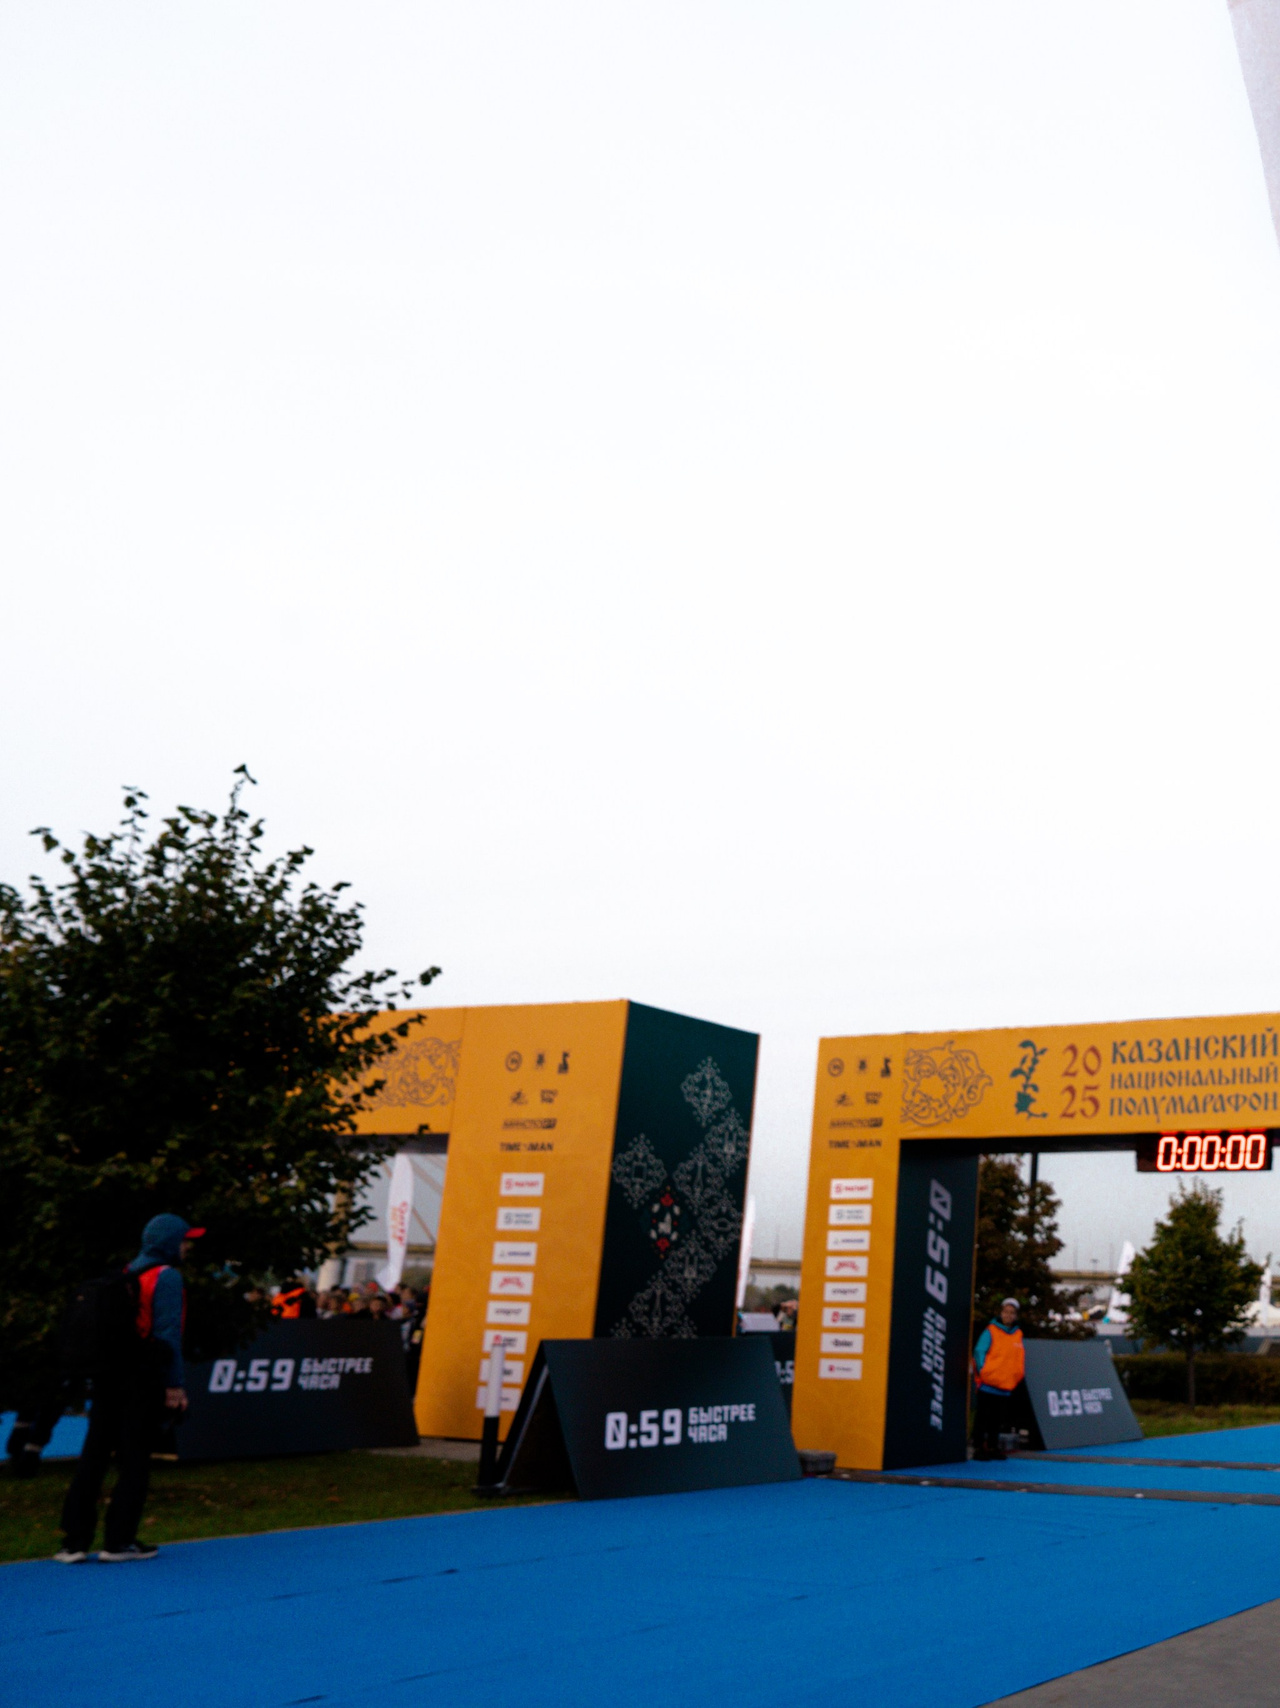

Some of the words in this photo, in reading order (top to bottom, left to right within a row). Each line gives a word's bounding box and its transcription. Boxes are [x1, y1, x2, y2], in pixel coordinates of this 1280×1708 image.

[1061, 1044, 1102, 1078] 20
[1111, 1027, 1279, 1064] КАЗАНСКИЙ
[1110, 1062, 1279, 1090] НАЦИОНАЛЬНЫЙ
[1060, 1084, 1101, 1119] 25
[1109, 1092, 1278, 1124] ПОЛУМАРАФОН
[1156, 1134, 1267, 1171] 0:00:00
[925, 1178, 951, 1304] 0:59
[208, 1358, 296, 1393] 0:59
[297, 1374, 341, 1390] ЧАСА
[300, 1357, 374, 1374] БЫСТРЕЕ
[687, 1403, 757, 1425] БЫСТРЕЕ
[1047, 1389, 1083, 1417] 0:59
[604, 1408, 683, 1450] 0:59
[687, 1424, 728, 1443] ЧАСА
